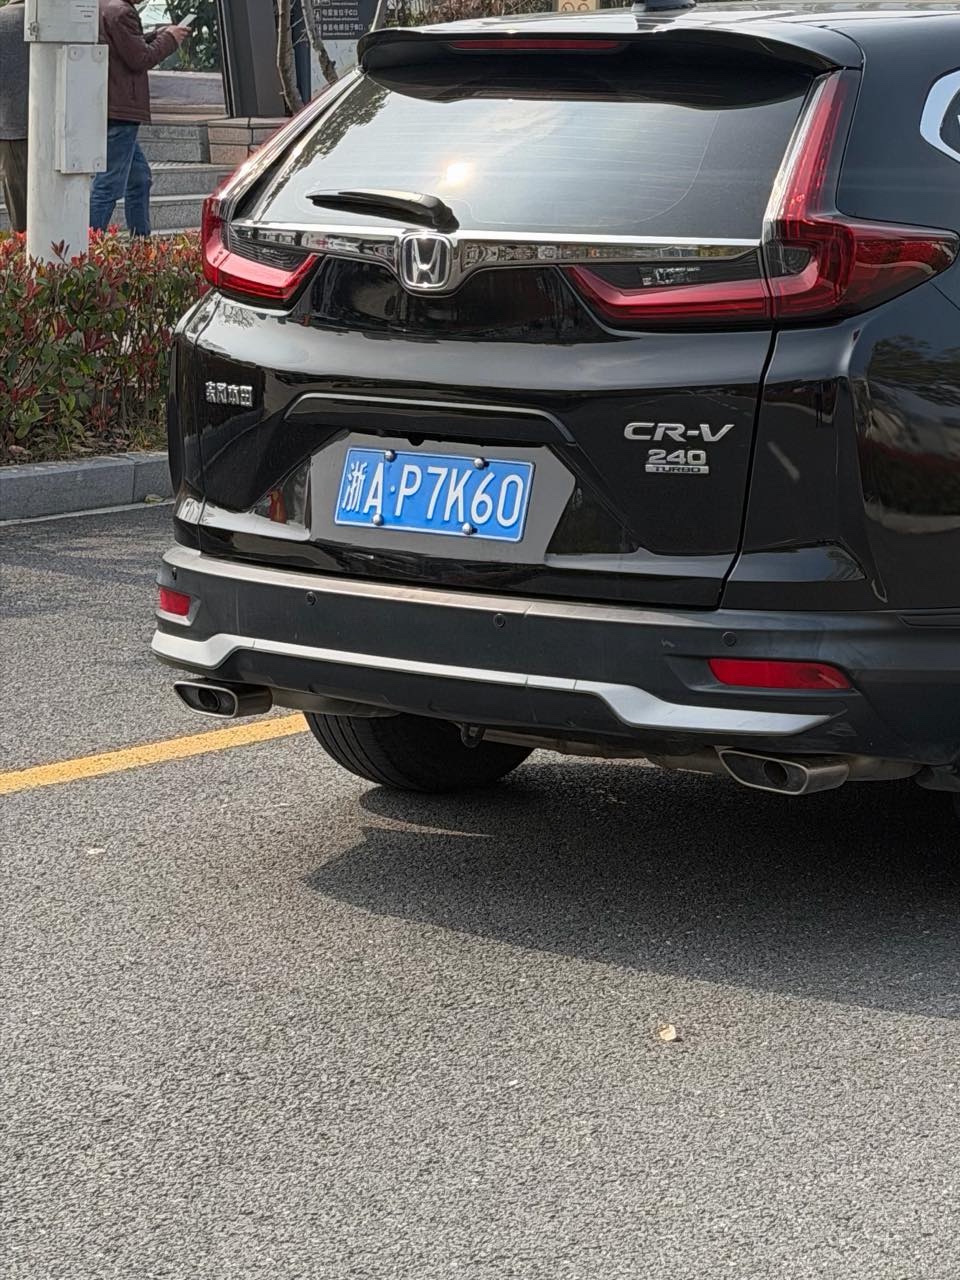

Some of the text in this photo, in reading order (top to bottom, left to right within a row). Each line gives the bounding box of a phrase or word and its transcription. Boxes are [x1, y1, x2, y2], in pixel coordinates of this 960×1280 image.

[623, 422, 735, 442] CR-V
[647, 449, 707, 465] 240
[653, 465, 702, 474] TURBO
